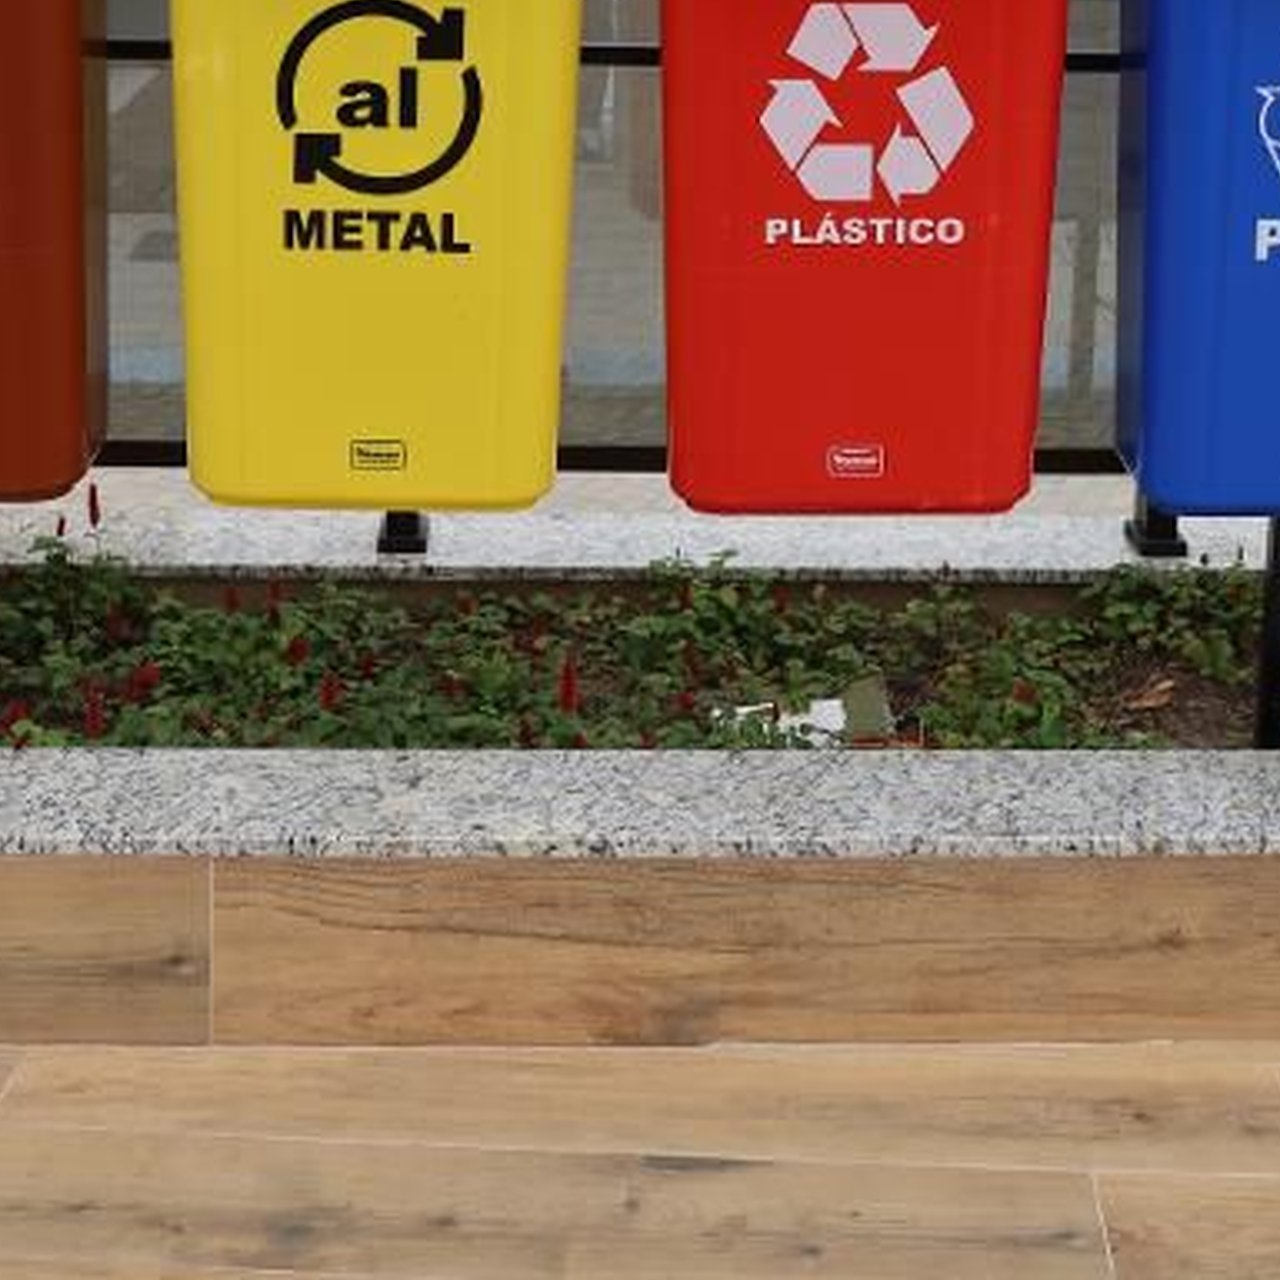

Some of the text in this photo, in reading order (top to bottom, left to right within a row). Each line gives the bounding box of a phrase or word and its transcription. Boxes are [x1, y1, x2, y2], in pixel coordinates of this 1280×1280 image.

[335, 66, 418, 128] al
[283, 209, 471, 254] METAL
[765, 211, 965, 245] PLÁSTICO
